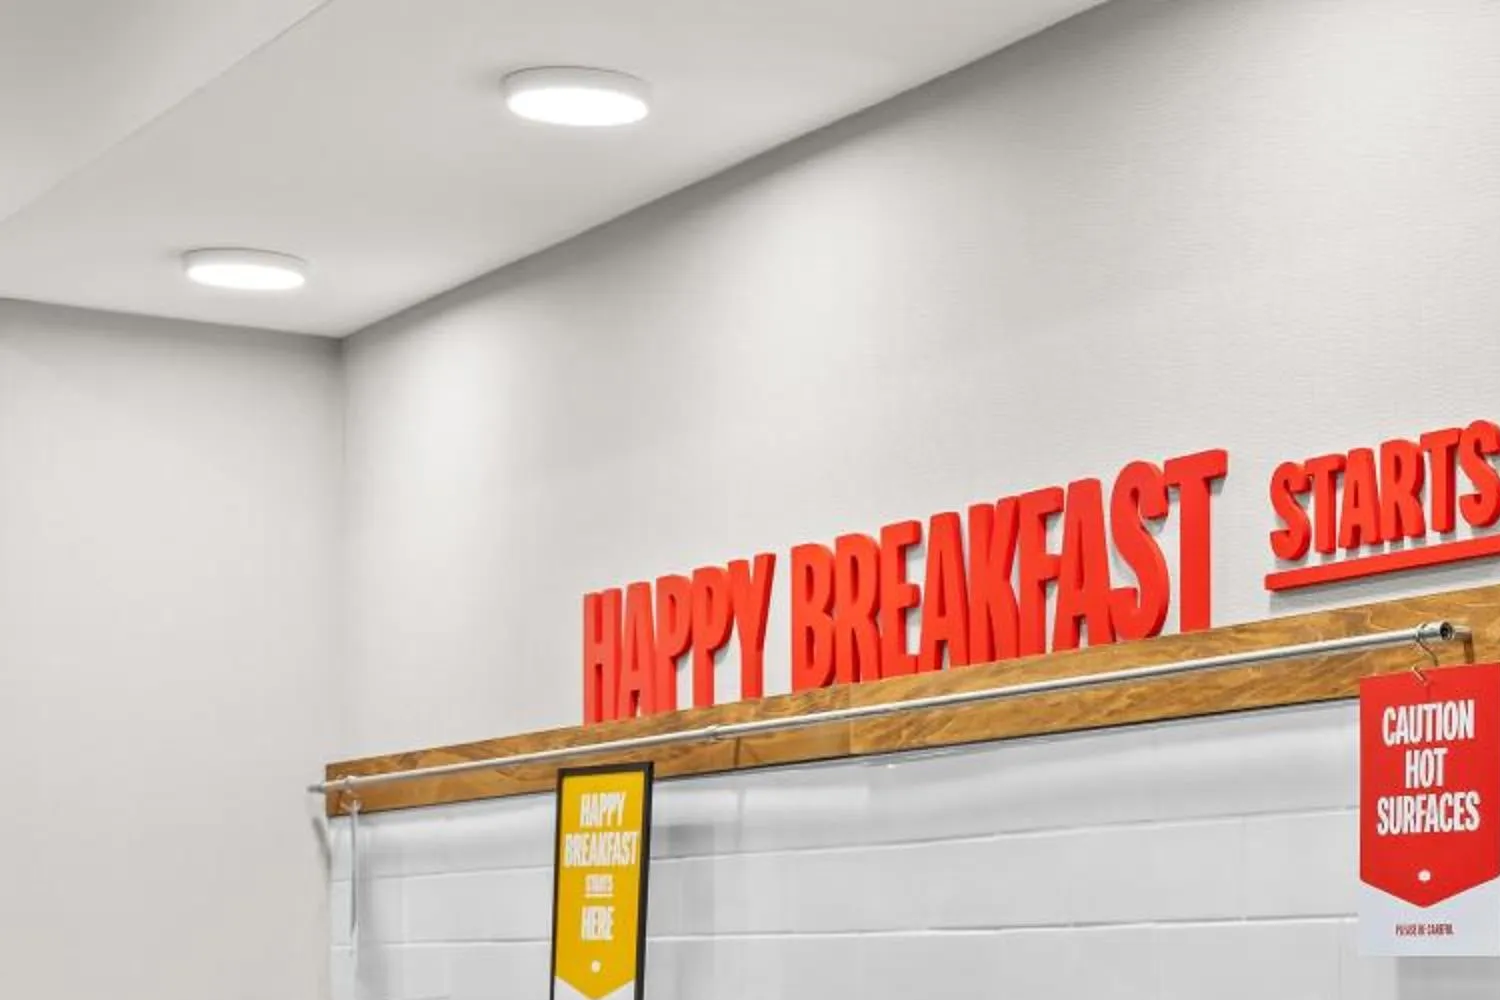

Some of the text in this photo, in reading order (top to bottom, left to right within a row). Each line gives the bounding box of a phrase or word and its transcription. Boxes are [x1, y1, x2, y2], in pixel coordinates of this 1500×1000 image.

[583, 553, 776, 725] HAPPY
[791, 449, 1228, 693] BREAKFAST
[1382, 698, 1475, 747] CAUTION
[1405, 747, 1449, 789] HOT
[580, 791, 627, 828] HAPPY
[1376, 789, 1482, 836] SURFACES
[564, 831, 640, 867] BREAKFAST
[581, 905, 616, 941] HERE
